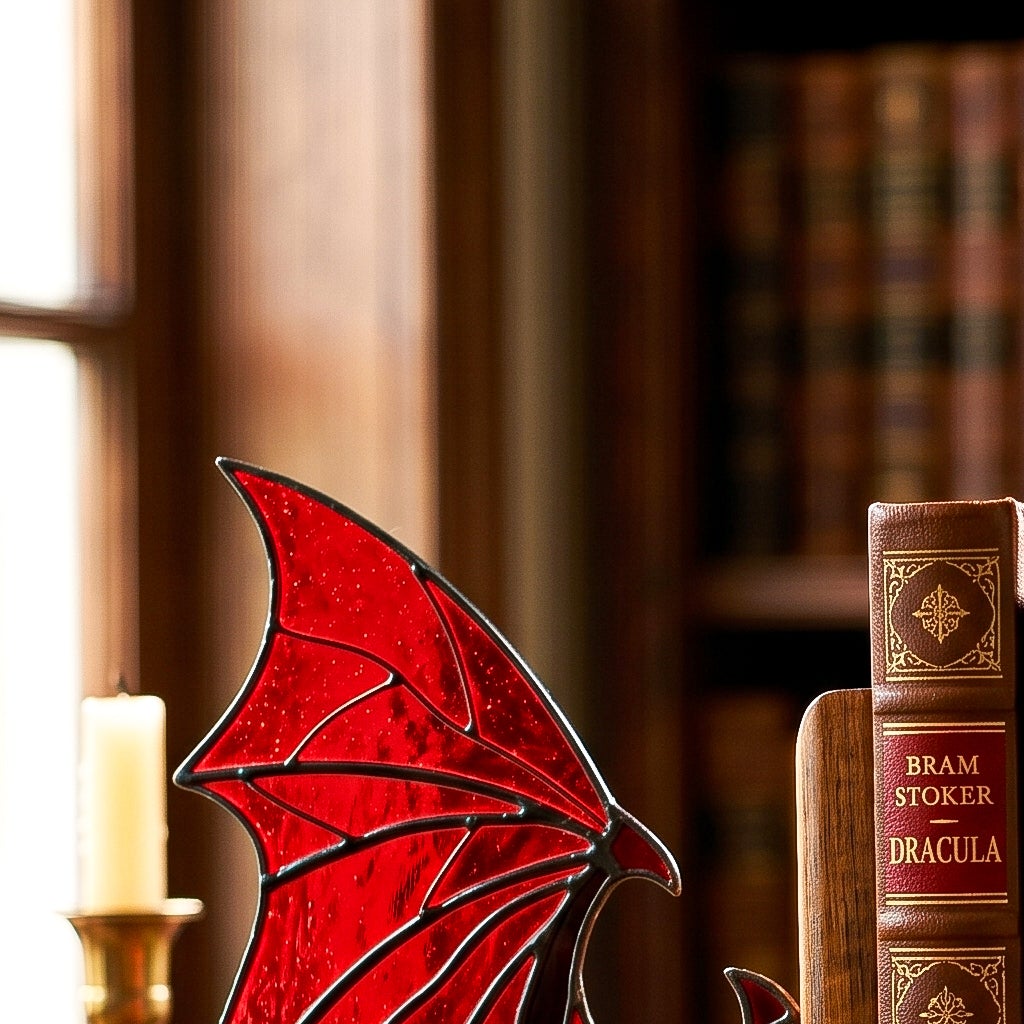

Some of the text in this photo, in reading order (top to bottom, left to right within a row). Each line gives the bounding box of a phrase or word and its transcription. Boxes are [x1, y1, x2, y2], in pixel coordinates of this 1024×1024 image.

[905, 755, 980, 776] BRAM
[895, 785, 995, 807] STOKER
[888, 835, 1003, 865] DRACULA
